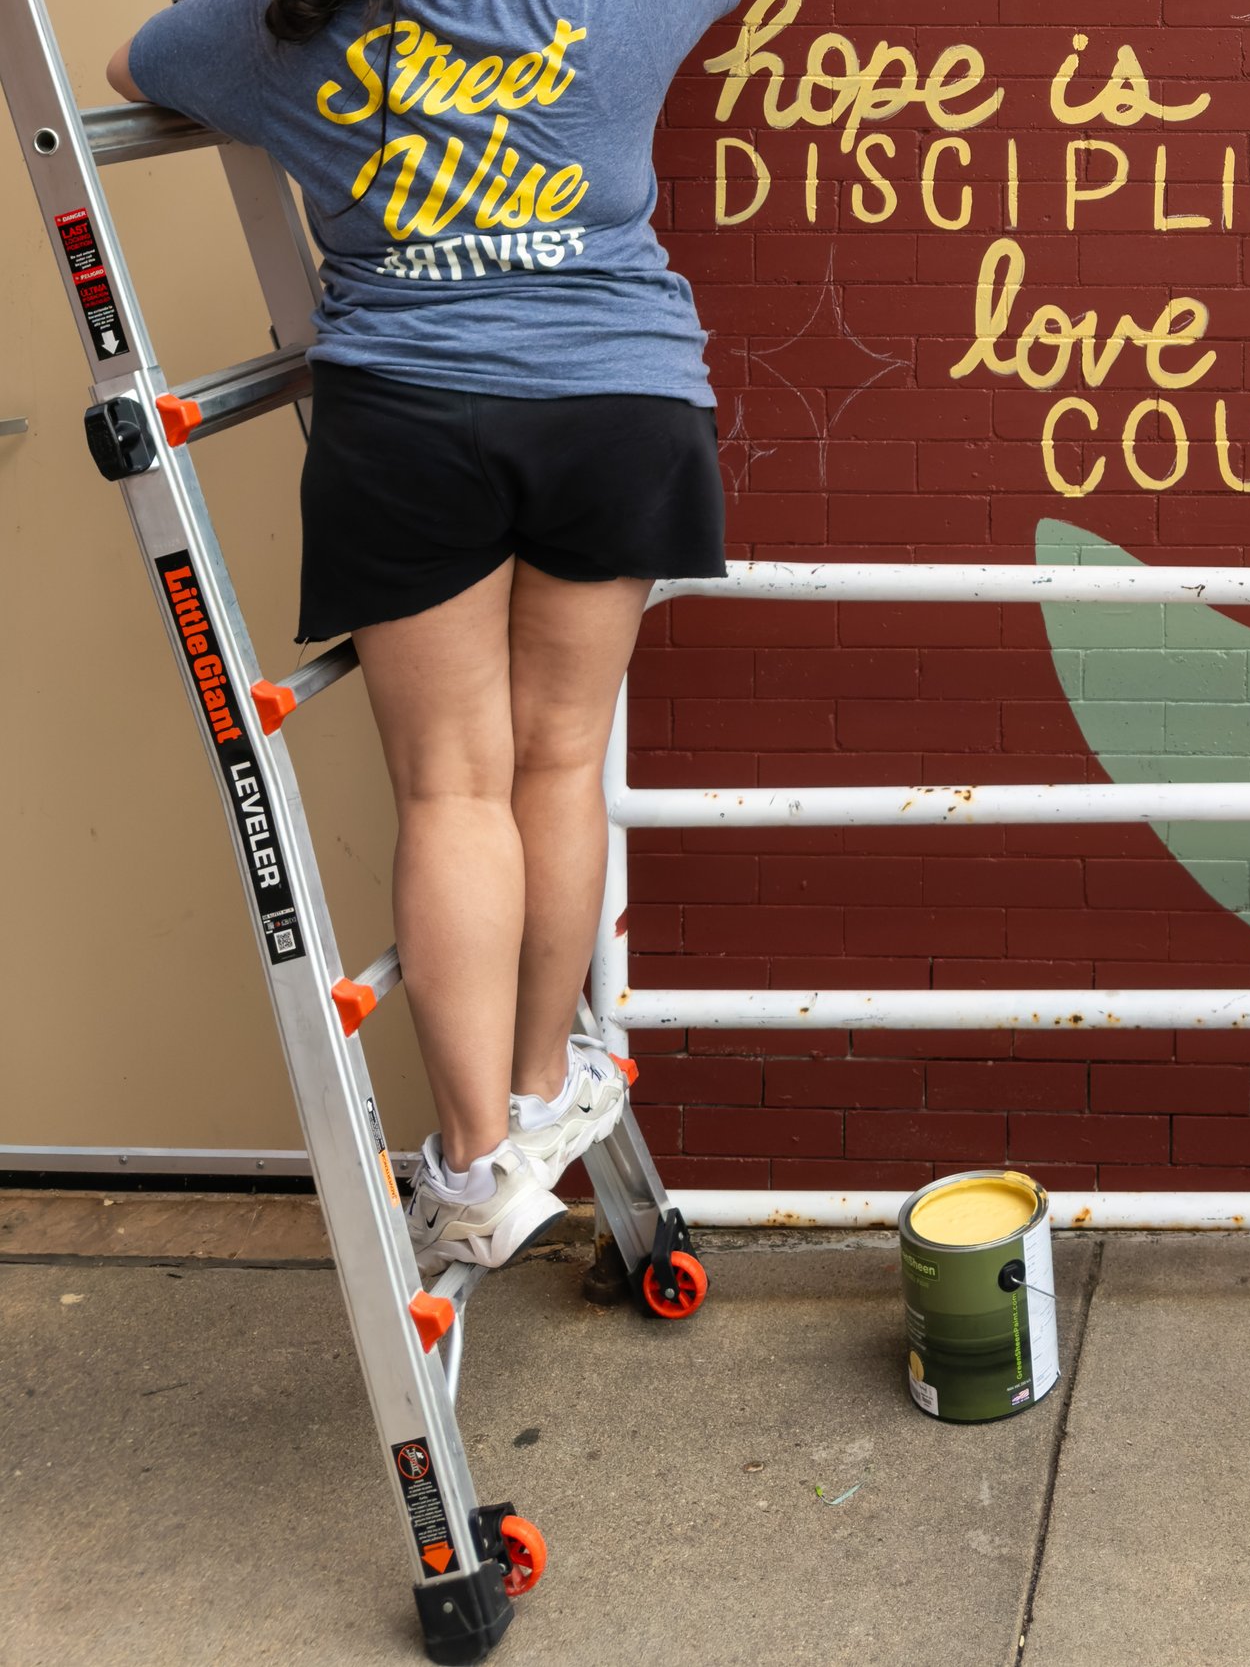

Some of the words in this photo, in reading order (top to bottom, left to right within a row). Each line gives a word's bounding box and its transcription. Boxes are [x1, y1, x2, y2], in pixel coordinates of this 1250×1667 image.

[316, 18, 588, 125] Street
[1049, 33, 1212, 127] is
[62, 223, 88, 239] LAST
[351, 114, 590, 240] Wise
[950, 237, 1217, 391] love
[164, 565, 209, 656] Little
[193, 654, 243, 744] Giant
[230, 761, 281, 889] LEVELER
[1011, 1292, 1023, 1380] GreenSheenPaint.com
